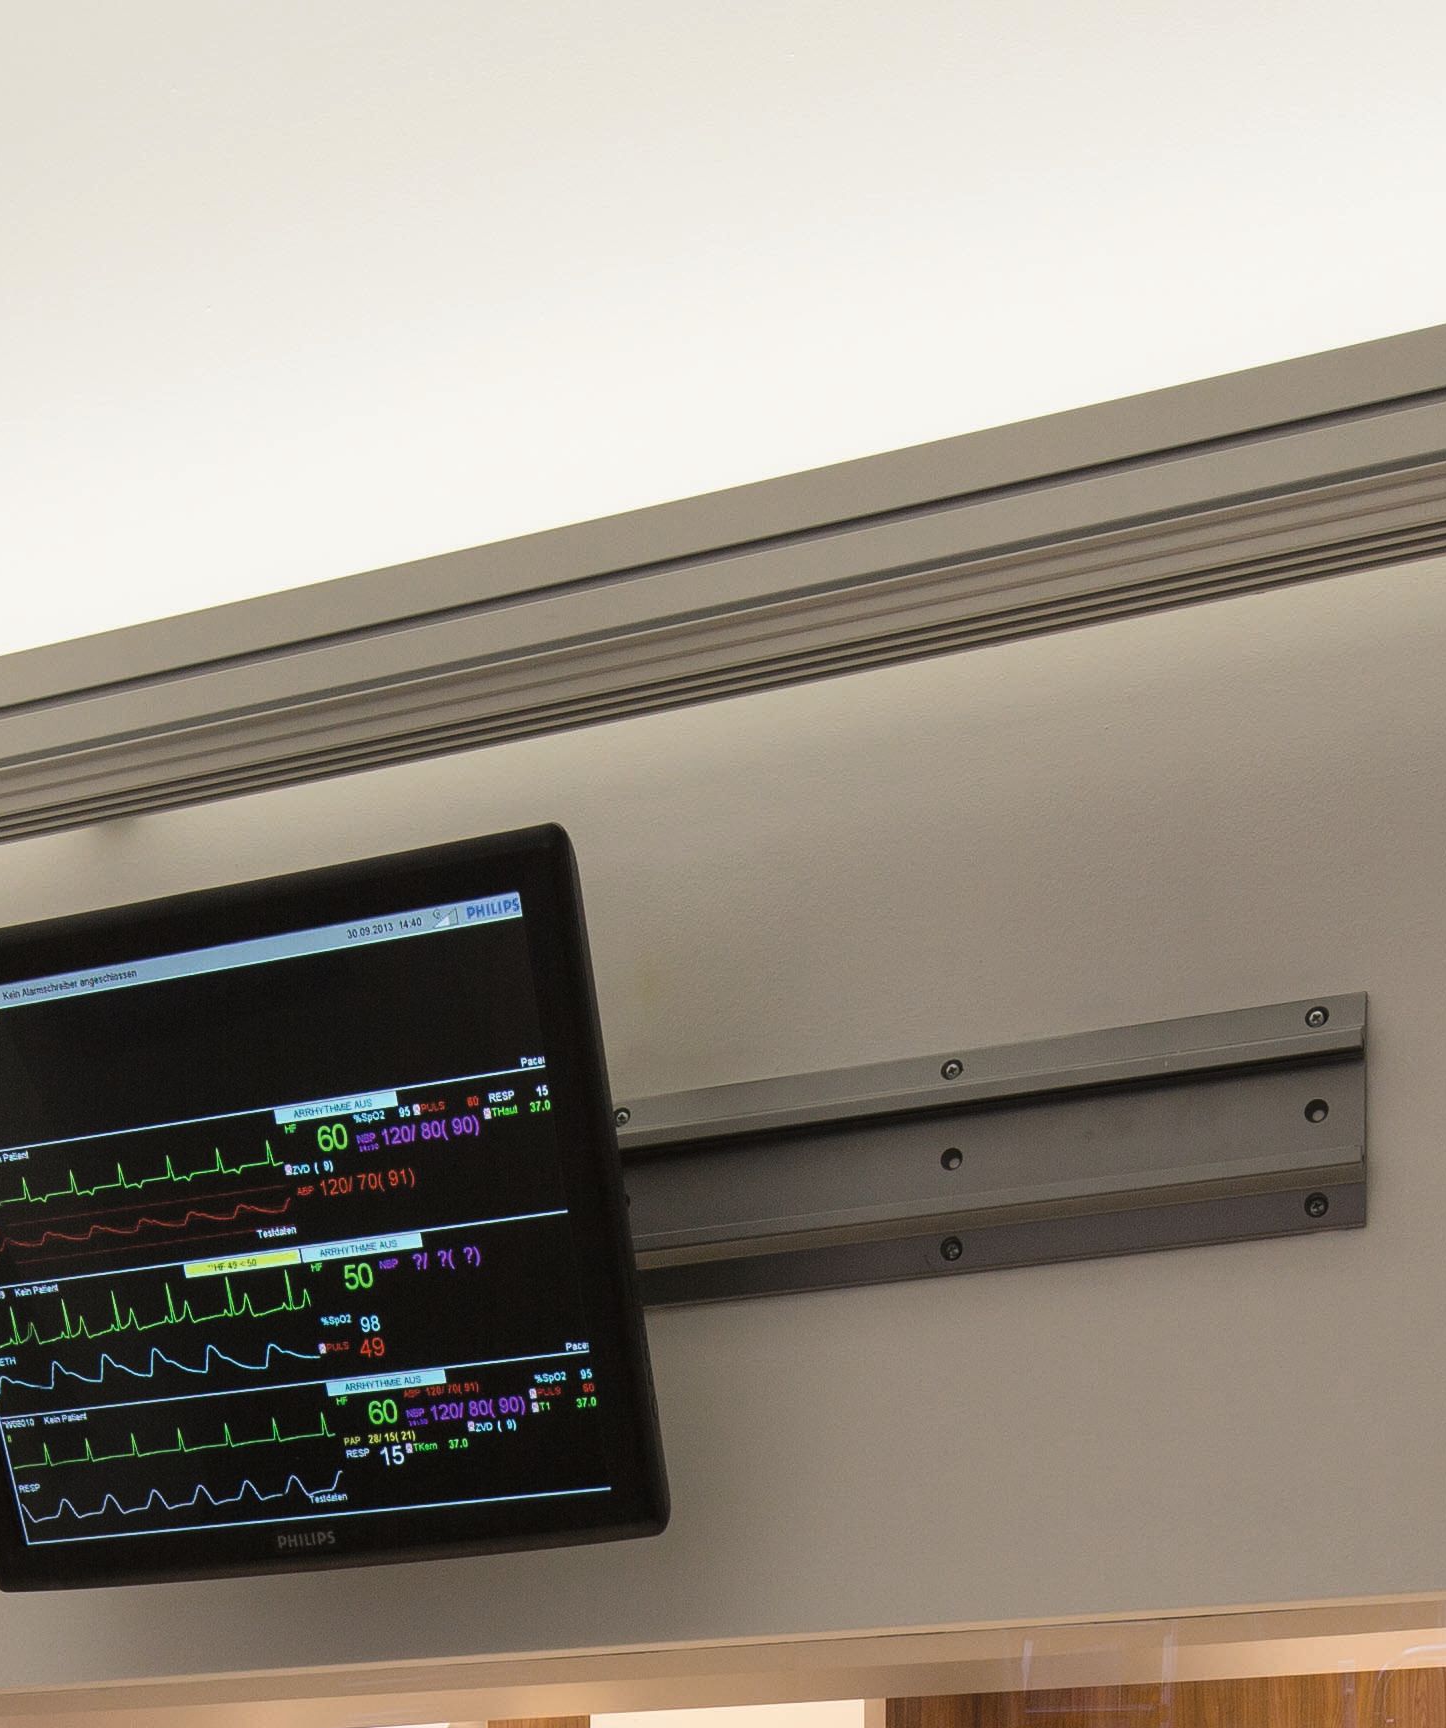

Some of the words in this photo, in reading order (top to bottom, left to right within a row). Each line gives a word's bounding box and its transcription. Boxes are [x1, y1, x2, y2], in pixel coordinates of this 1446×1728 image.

[466, 898, 520, 919] PHILIPS
[347, 924, 393, 939] 30.09.2013
[399, 917, 422, 929] 14:40
[2, 990, 20, 1000] Kein
[22, 980, 77, 996] Alarmschreiber
[80, 970, 137, 986] angeschlossen
[488, 1090, 514, 1103] RESP
[536, 1085, 548, 1097] 15
[354, 1098, 372, 1109] AUS
[530, 1101, 551, 1113] 37.0
[317, 1123, 347, 1152] 60
[3, 1151, 29, 1162] Patient
[380, 1239, 398, 1249] AUS
[344, 1262, 374, 1290] 50
[33, 1284, 58, 1294] Patient
[321, 1314, 352, 1326] %SpO2
[360, 1315, 380, 1332] 98
[326, 1342, 349, 1352] PULS
[360, 1336, 385, 1358] 49
[404, 1375, 421, 1386] AUS
[534, 1371, 567, 1383] %SpO2
[580, 1368, 592, 1380] 95
[576, 1397, 597, 1409] 37.0
[62, 1412, 87, 1422] Patient
[368, 1398, 397, 1425] 60
[344, 1436, 361, 1446] PAP
[449, 1438, 468, 1449] 37.0
[346, 1449, 370, 1459] RESP
[380, 1445, 404, 1467] 15
[18, 1484, 41, 1494] RESP
[310, 1493, 348, 1504] Testdaten
[277, 1531, 336, 1549] PHILIPS
